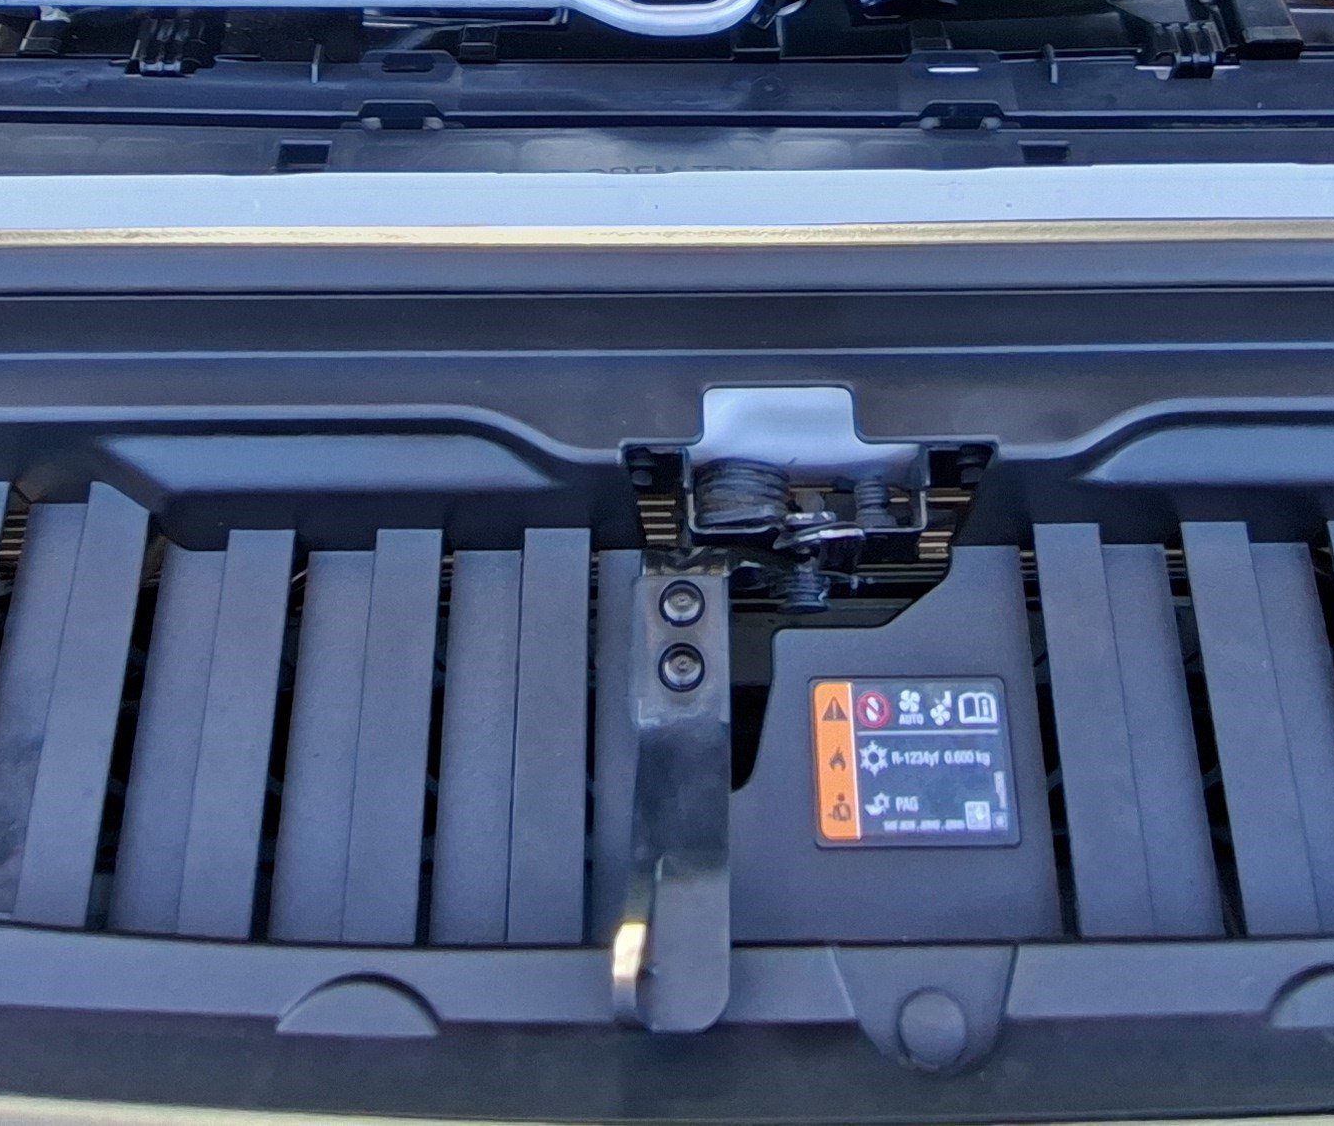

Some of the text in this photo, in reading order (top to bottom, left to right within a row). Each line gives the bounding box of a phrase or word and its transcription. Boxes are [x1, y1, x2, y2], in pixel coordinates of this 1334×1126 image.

[898, 714, 924, 726] AUTO
[977, 751, 991, 767] kg
[895, 795, 919, 812] PAG
